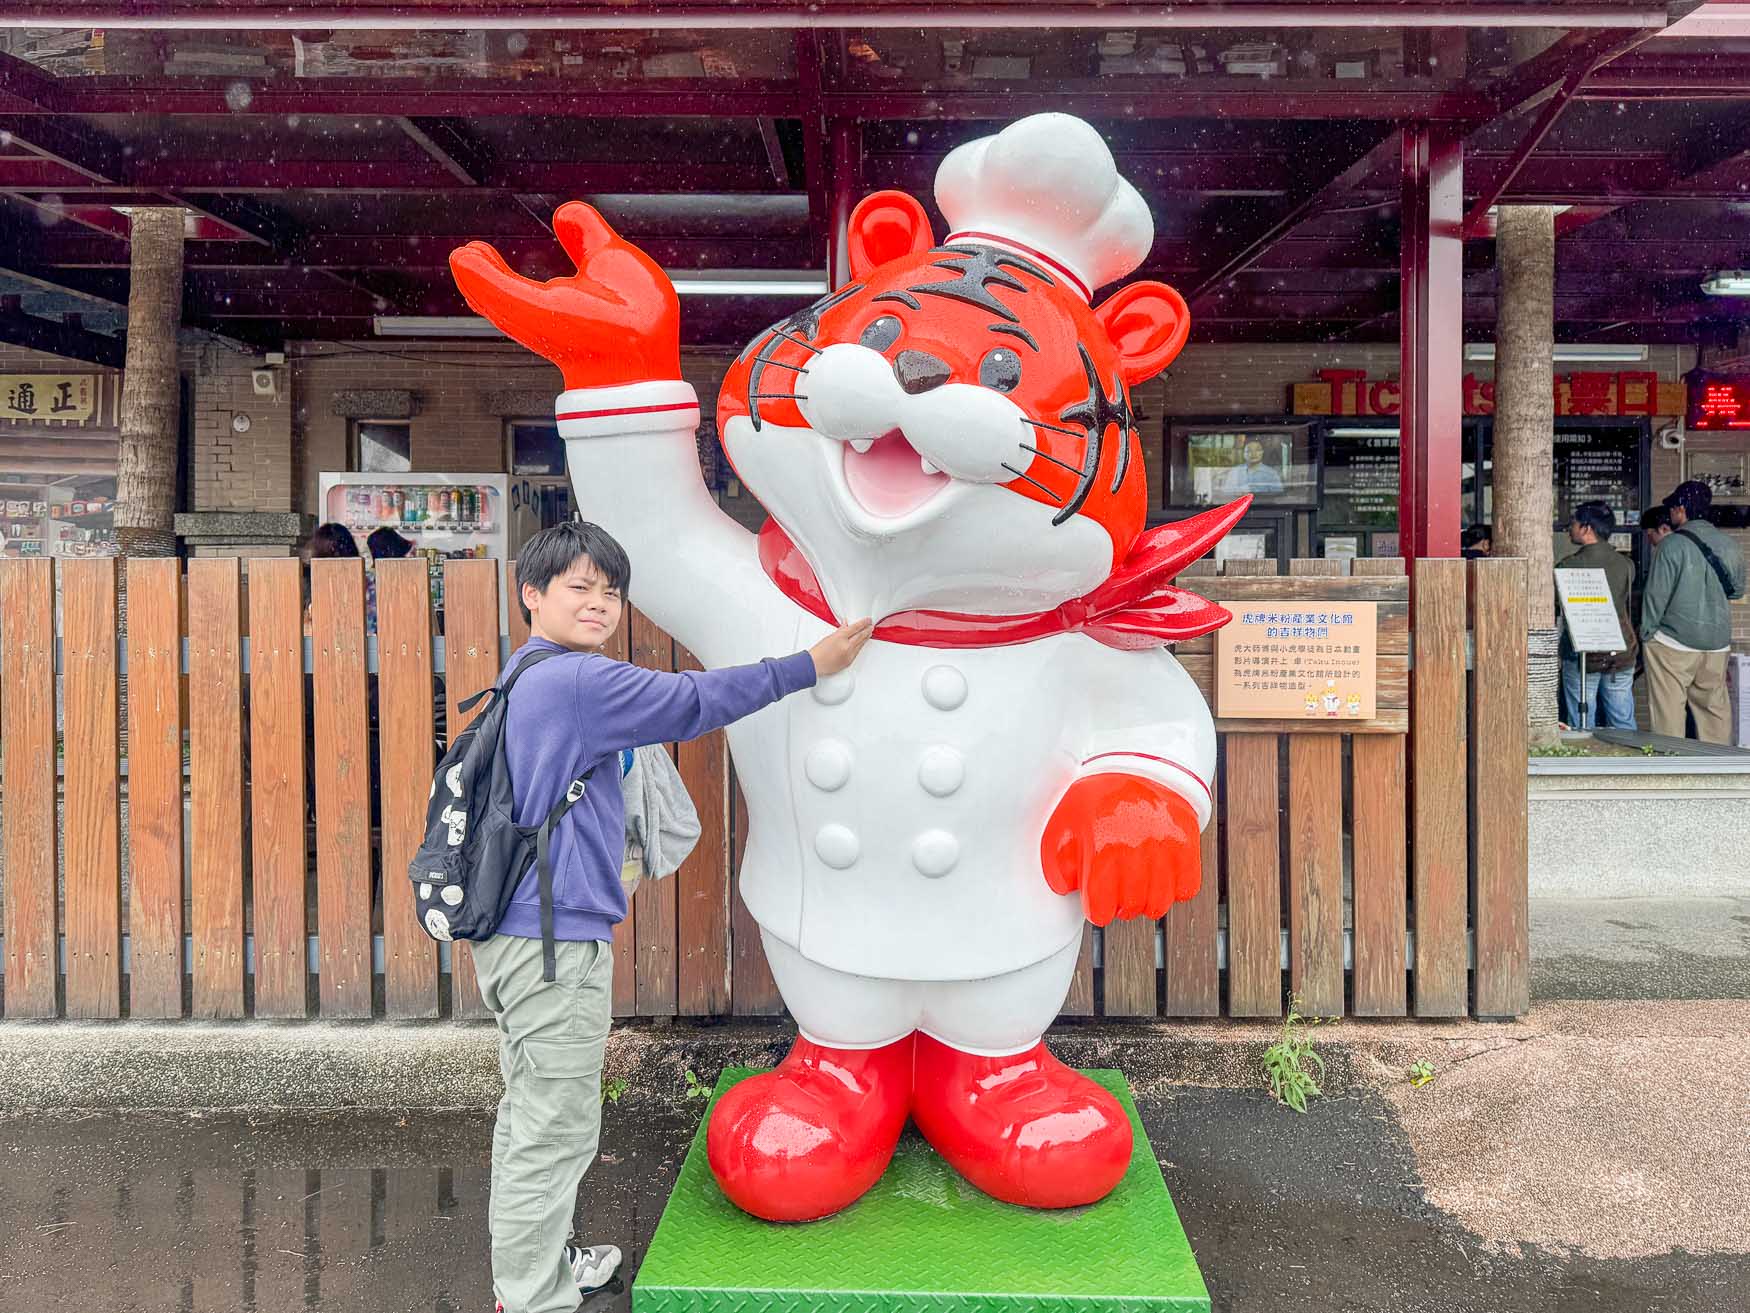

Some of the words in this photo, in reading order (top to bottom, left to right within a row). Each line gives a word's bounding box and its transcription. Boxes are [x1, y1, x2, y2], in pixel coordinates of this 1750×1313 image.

[1319, 369, 1495, 416] Ticts
[1553, 371, 1657, 416] 票口
[1267, 627, 1329, 639] 的吉祥物們
